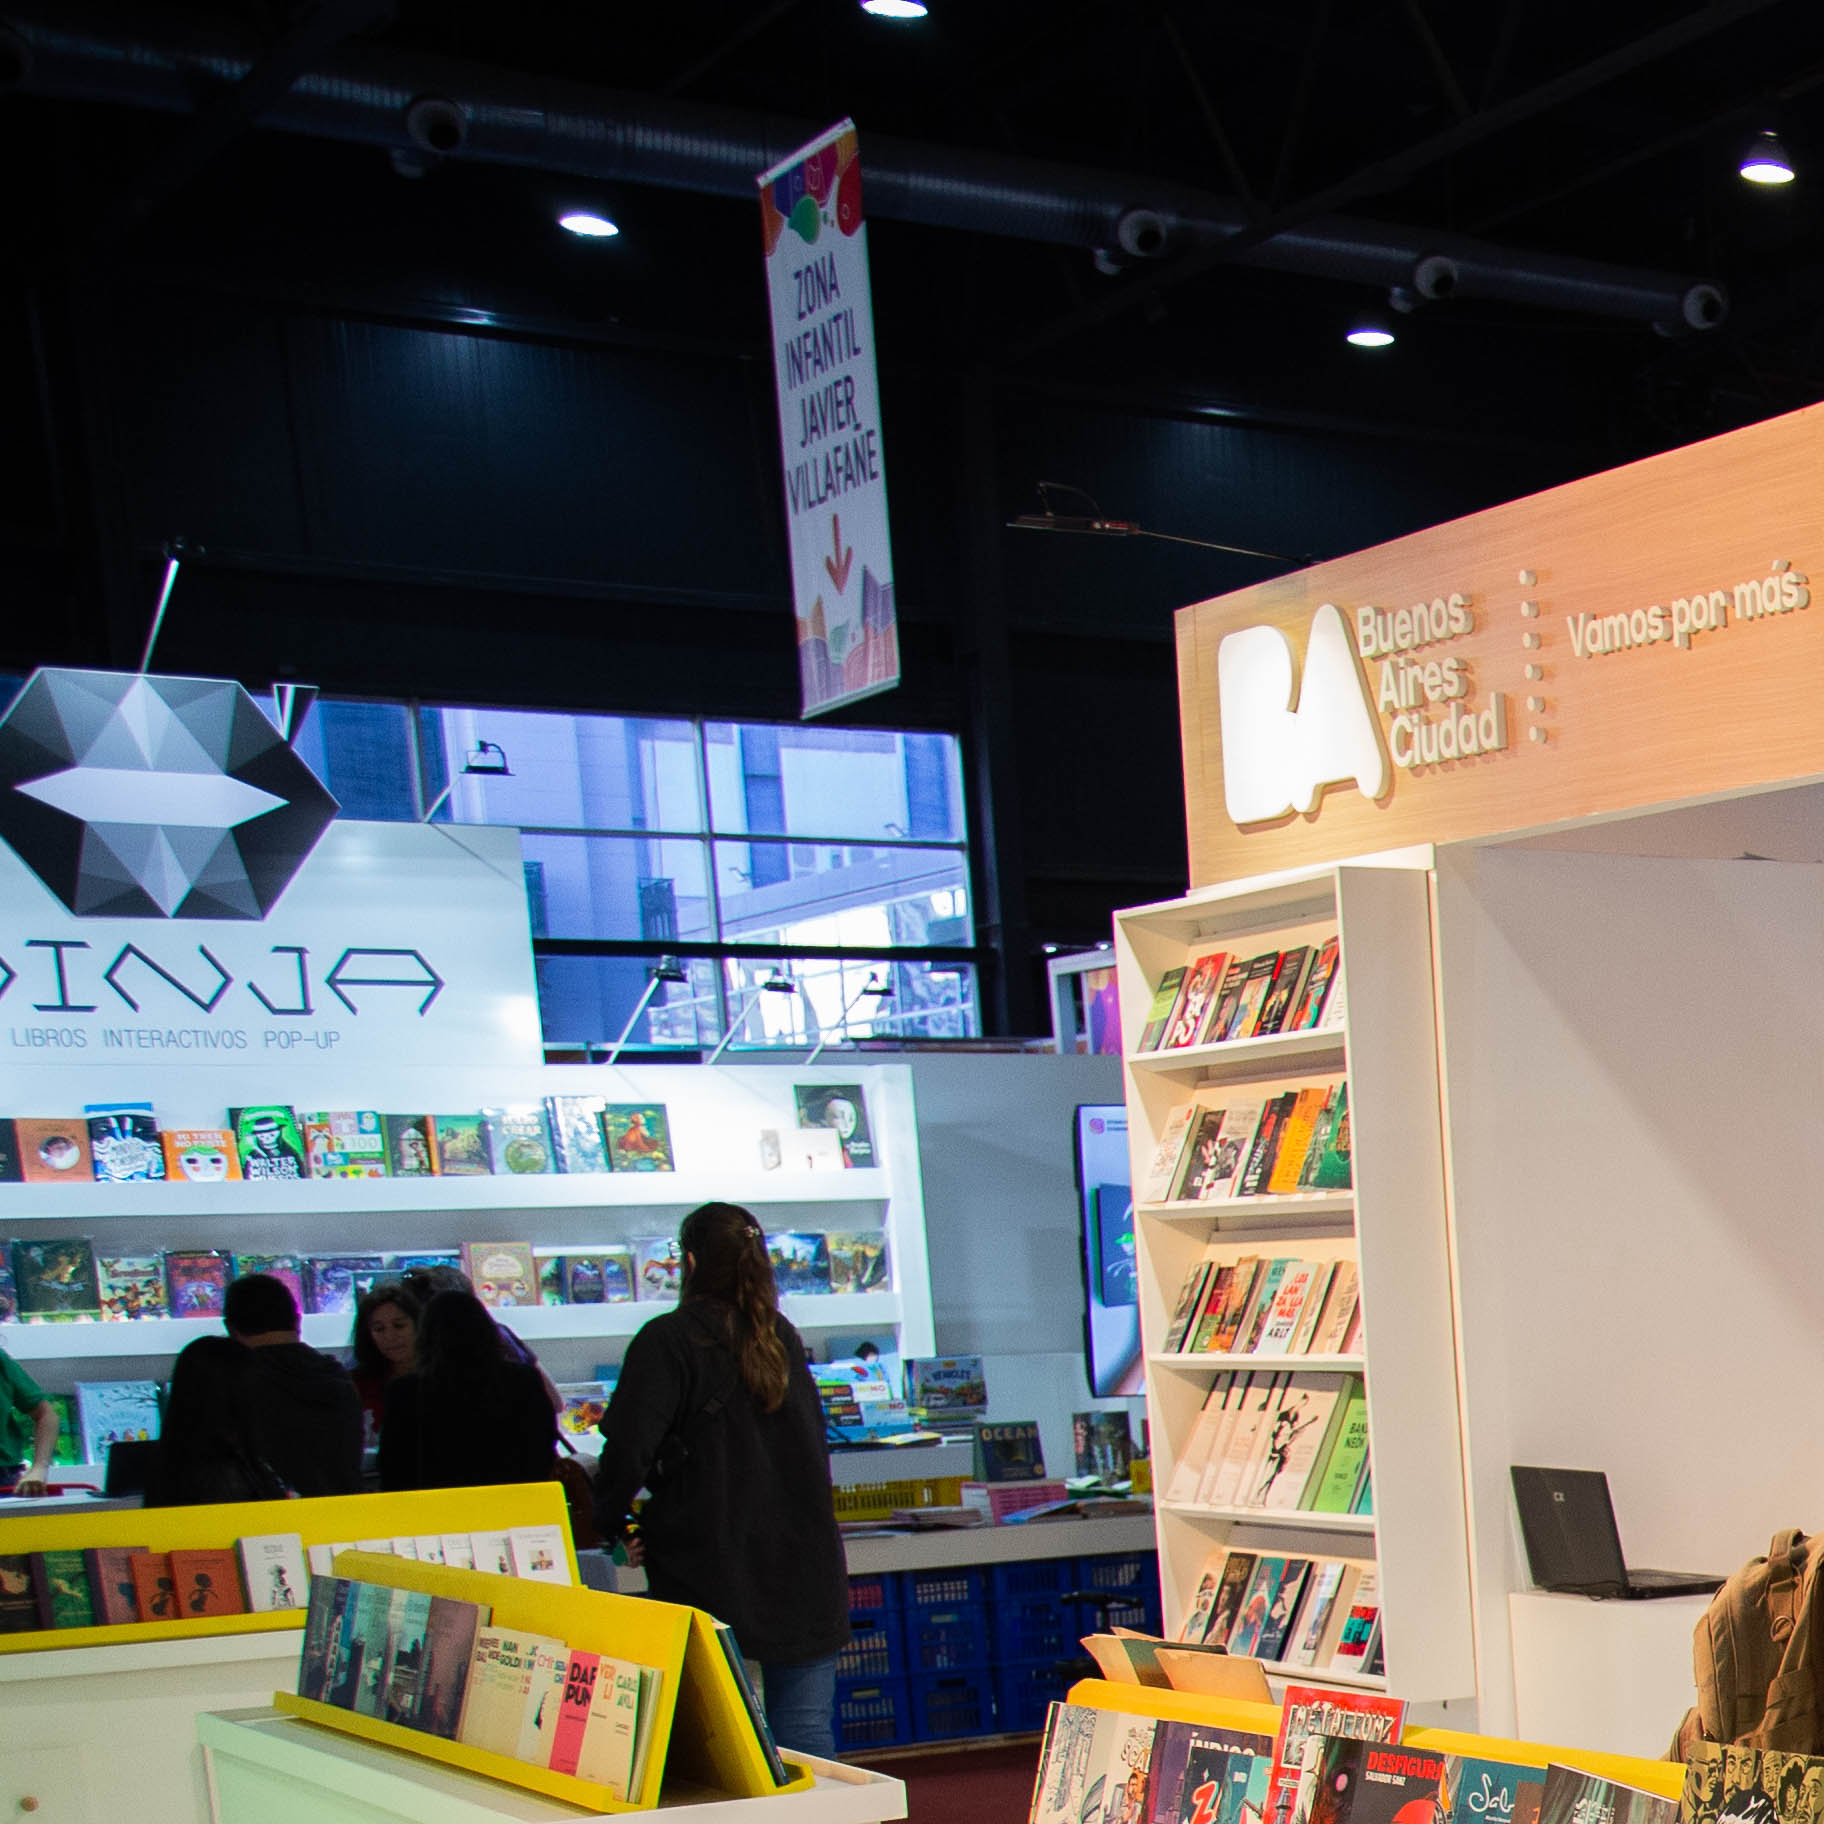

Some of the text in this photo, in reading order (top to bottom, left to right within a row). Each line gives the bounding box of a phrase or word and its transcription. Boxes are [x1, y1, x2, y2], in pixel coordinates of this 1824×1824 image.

[793, 252, 841, 321] ZONA
[784, 308, 862, 391] INFANTIL
[797, 375, 860, 449] JAVIER
[1356, 593, 1472, 658] Buenos
[1567, 560, 1808, 658] Vamos por más
[1217, 604, 1387, 824] BA
[1377, 655, 1466, 714] Aires
[1390, 692, 1506, 769] Ciudad
[0, 939, 445, 1016] INJA
[12, 1028, 341, 1051] LIBROS INTERACTIVOS POP-UP
